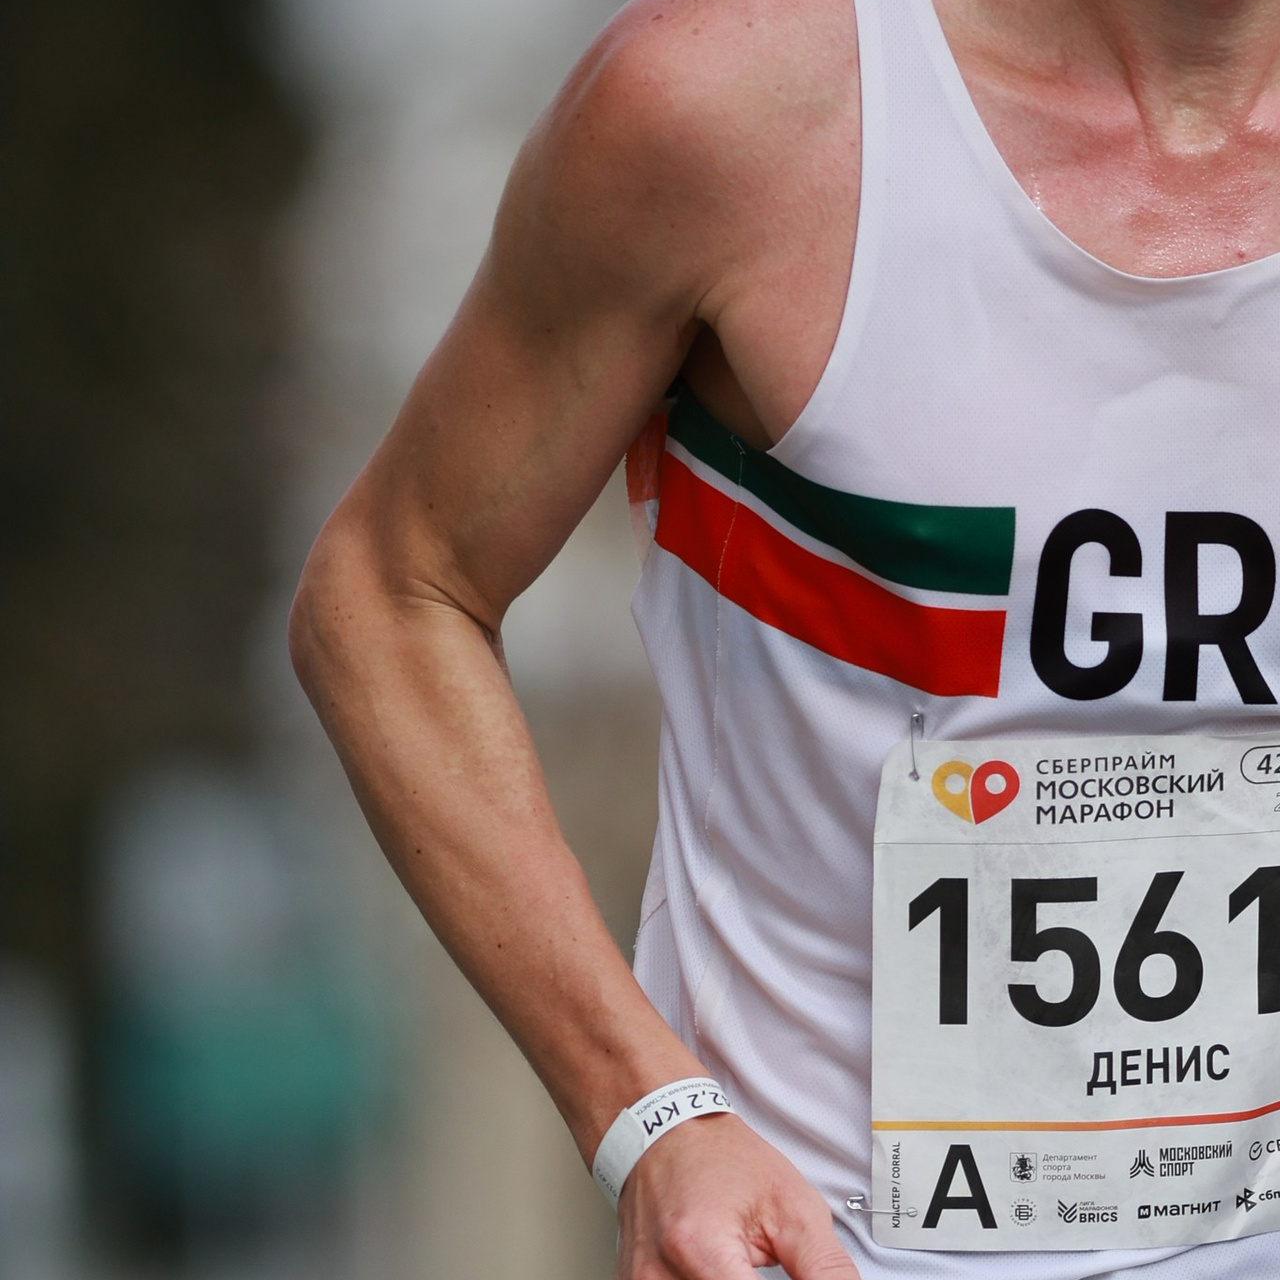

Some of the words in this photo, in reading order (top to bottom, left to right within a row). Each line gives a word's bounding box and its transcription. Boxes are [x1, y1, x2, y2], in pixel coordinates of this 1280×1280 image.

[1035, 750, 1176, 775] СБЕРПРАЙМ
[1035, 768, 1225, 800] МОСКОВСКИЙ
[1035, 799, 1175, 825] МАРАФОН
[1086, 1043, 1231, 1096] ДЕНИС
[892, 1142, 901, 1179] CORRAL
[1042, 1153, 1098, 1163] Департамент
[1159, 1140, 1233, 1162] МОСКОВСКИЙ
[1042, 1164, 1072, 1173] спорта
[1042, 1173, 1072, 1182] города
[1159, 1162, 1195, 1178] СПОРТ
[892, 1187, 901, 1229] КЛАСТЕР
[1079, 1212, 1118, 1223] BRICS
